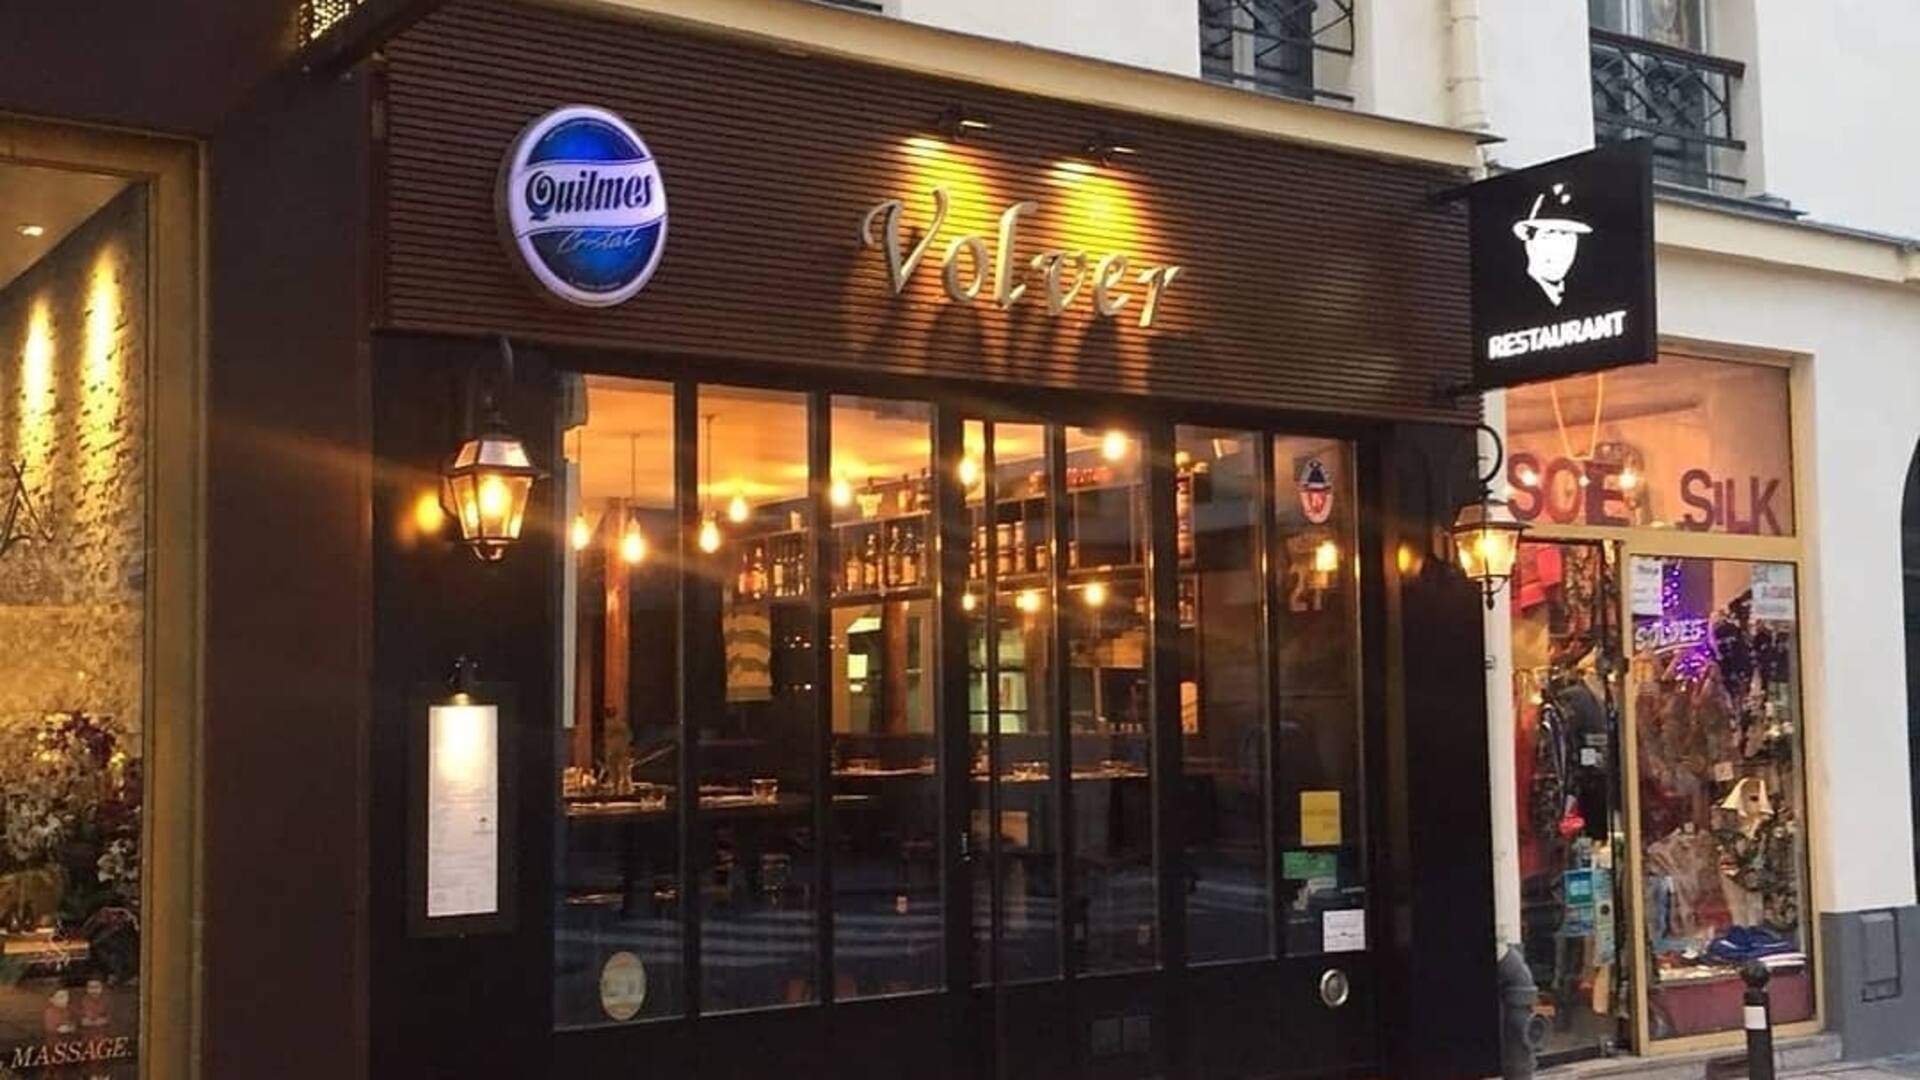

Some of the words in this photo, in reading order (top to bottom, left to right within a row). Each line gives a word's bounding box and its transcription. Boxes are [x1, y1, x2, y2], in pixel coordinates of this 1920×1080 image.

[525, 170, 653, 221] Quilmes
[862, 187, 1184, 328] Volver
[1488, 310, 1627, 360] RESTAURANT
[1507, 452, 1630, 527] SOE
[1678, 468, 1781, 536] SILK
[1634, 618, 1708, 651] SOLDES
